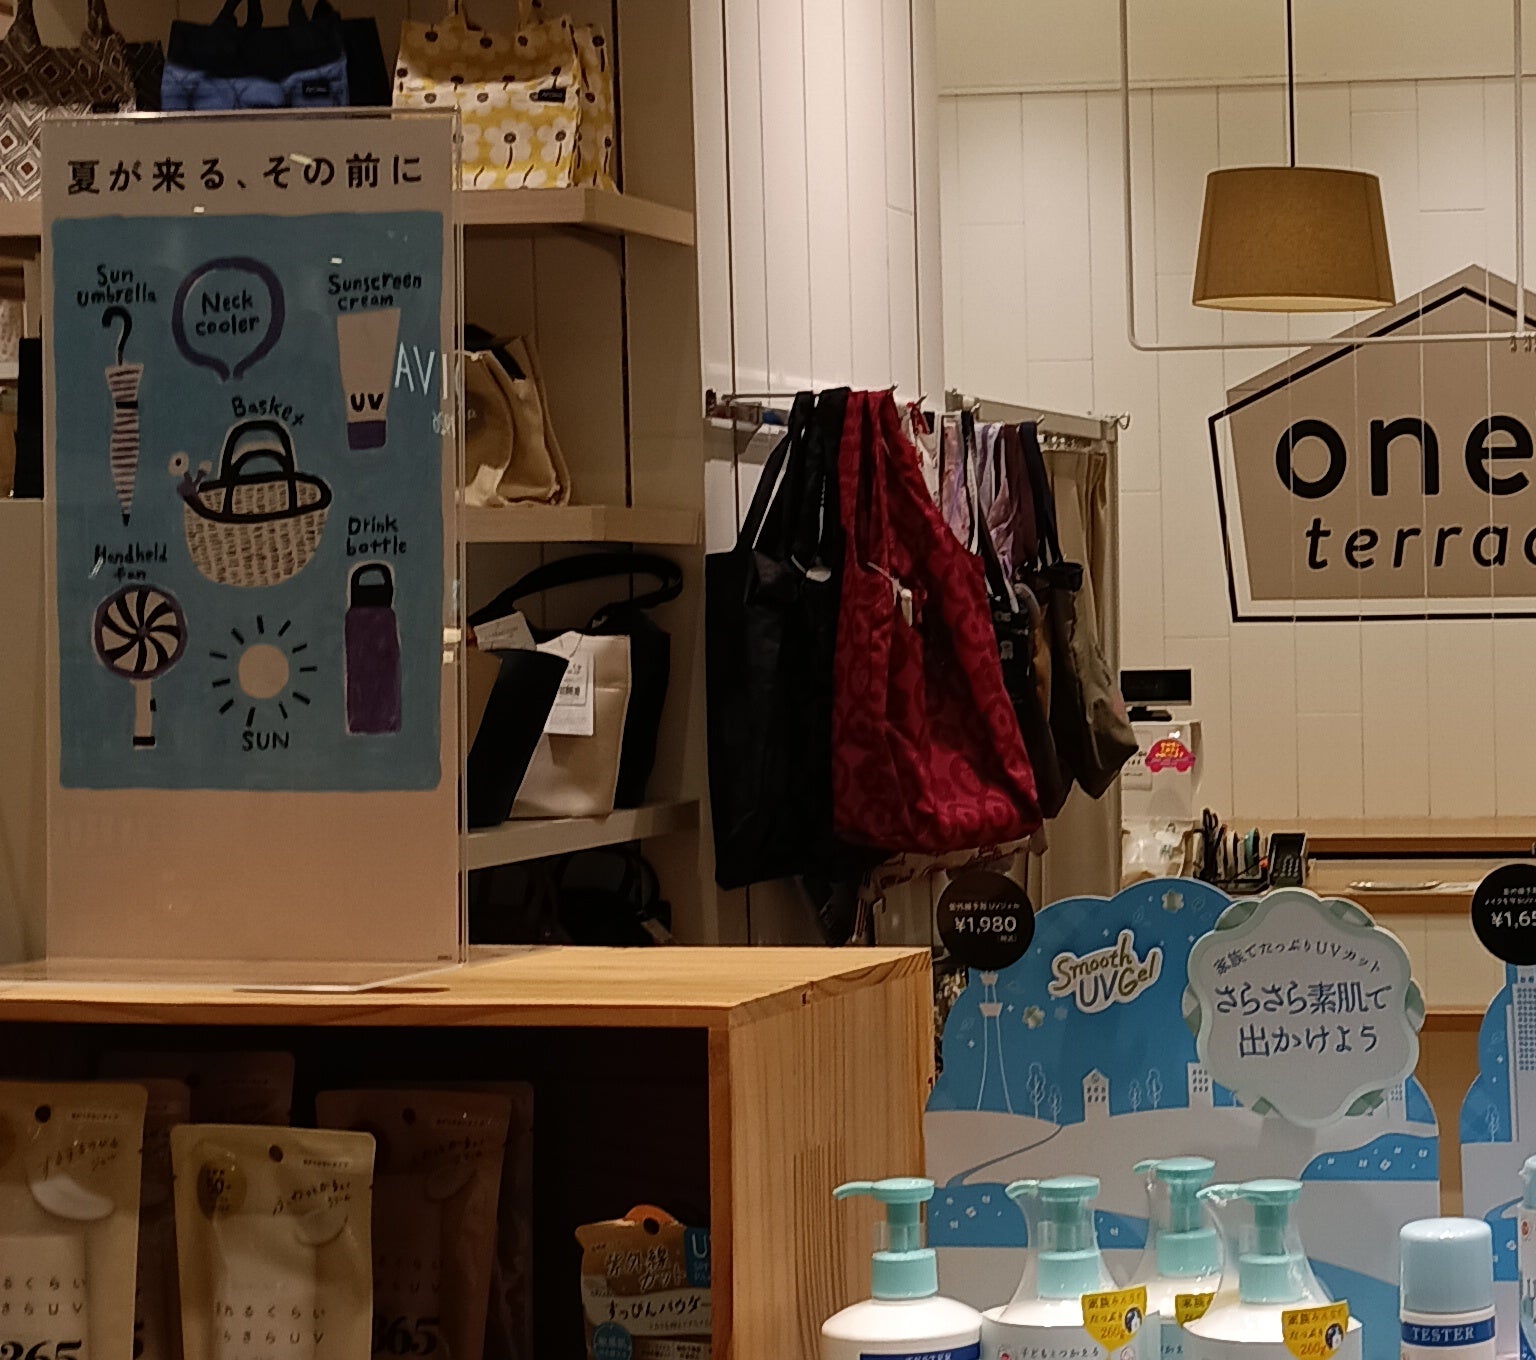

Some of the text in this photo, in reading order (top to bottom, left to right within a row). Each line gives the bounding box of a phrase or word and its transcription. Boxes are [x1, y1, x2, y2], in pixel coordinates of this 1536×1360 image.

[67, 152, 423, 194] 夏が来る、その前に
[96, 263, 134, 285] Sun
[328, 271, 423, 294] Sunscreen
[76, 283, 158, 308] umbrella
[201, 290, 255, 312] Neck
[337, 290, 395, 311] cream
[195, 311, 260, 336] cooler
[350, 392, 384, 412] UV
[347, 516, 398, 536] Drink
[94, 544, 169, 565] Handheld
[345, 537, 406, 556] bottle
[113, 565, 146, 581] fan
[241, 729, 290, 751] SUN
[954, 916, 1016, 934] ¥1,980
[1053, 932, 1133, 991] Smooth
[1079, 957, 1156, 1003] UV Gel
[1238, 1024, 1378, 1058] 出かけよう
[1411, 1326, 1475, 1342] TESTER
